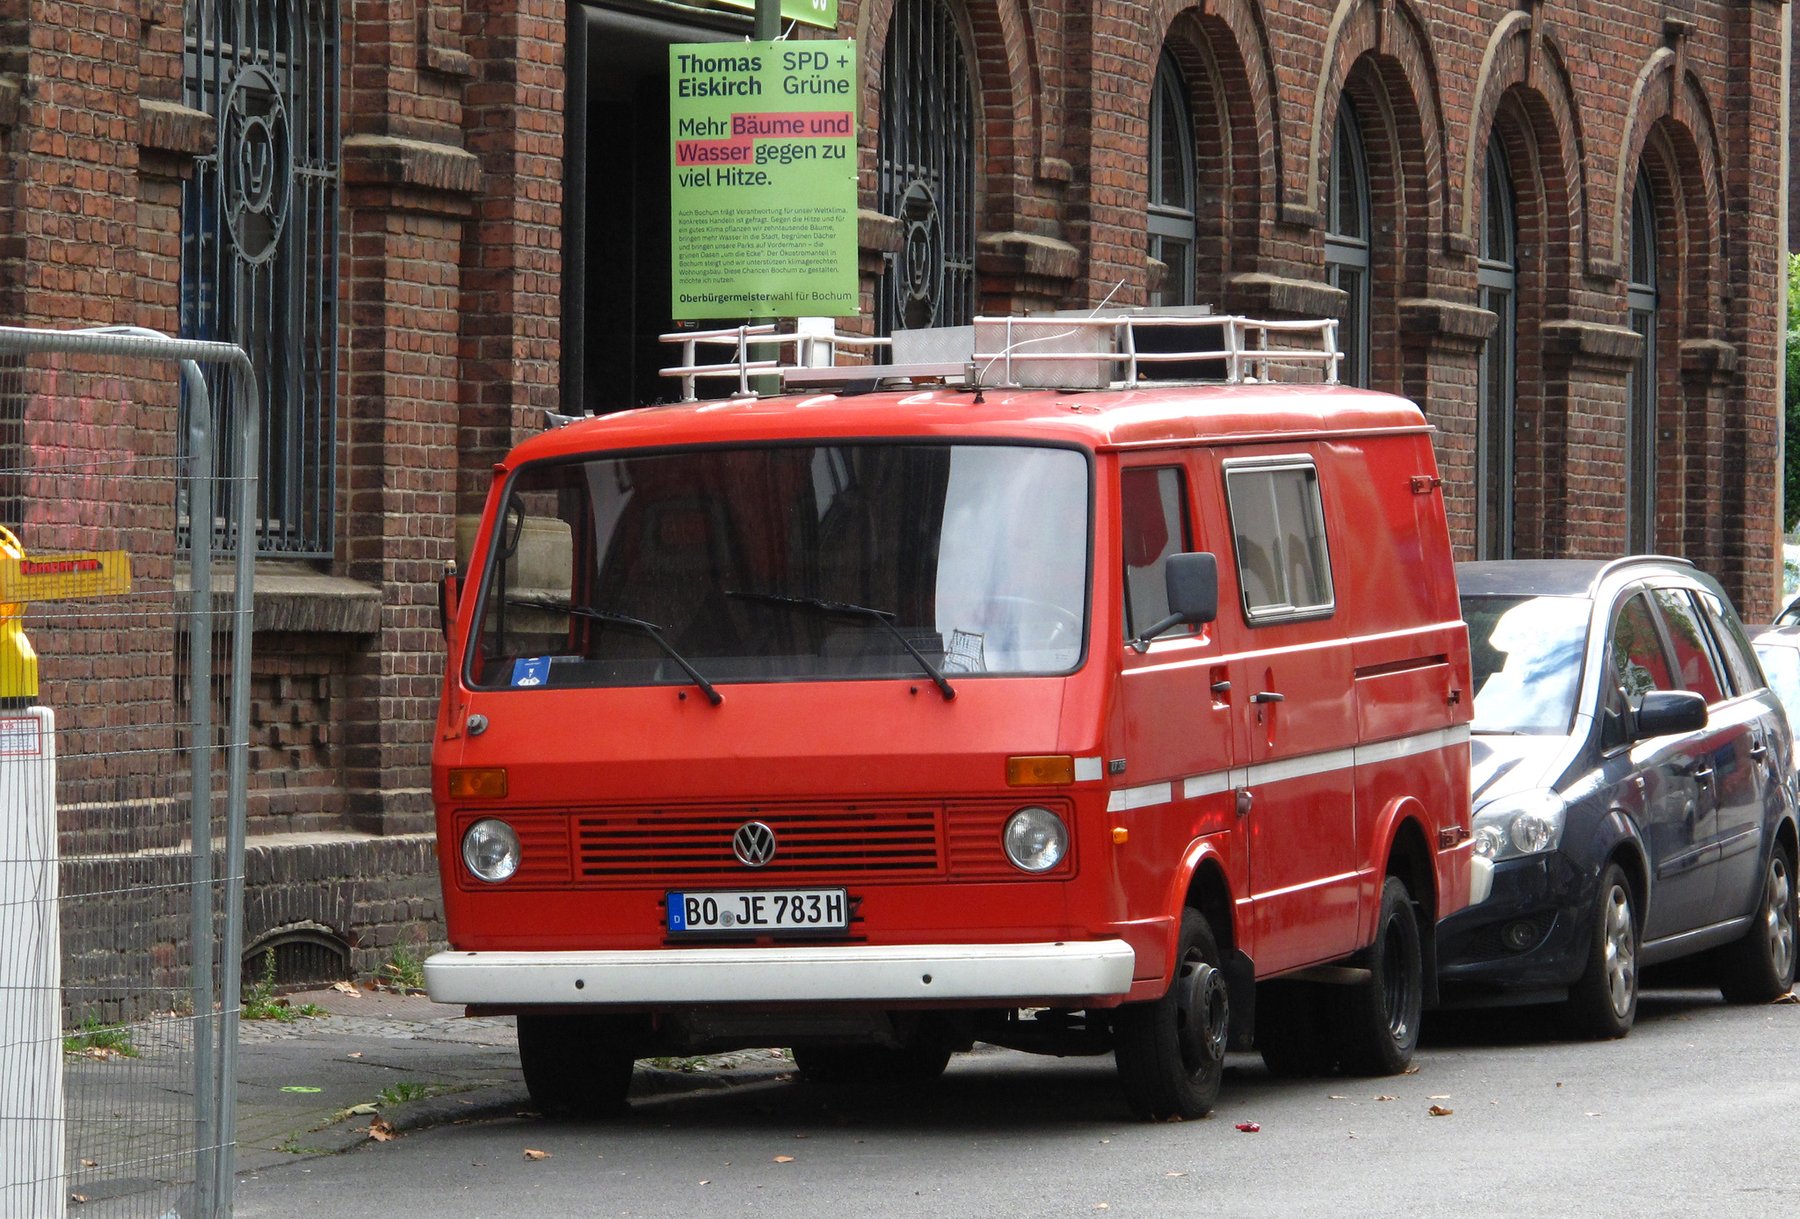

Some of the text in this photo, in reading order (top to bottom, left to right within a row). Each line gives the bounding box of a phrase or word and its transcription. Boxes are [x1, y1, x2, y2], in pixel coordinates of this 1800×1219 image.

[678, 54, 762, 73] Thomas
[783, 52, 848, 71] SPD +
[679, 76, 762, 97] Eiskirch
[783, 75, 850, 94] Grüne
[679, 114, 849, 136] Mehr Bäume und
[678, 143, 845, 164] Wasser gegen zu
[678, 167, 772, 187] viel Hitze.
[679, 291, 852, 303] Oberbürgermeisterwahl für Bochum
[674, 915, 681, 923] D
[686, 897, 718, 925] BO
[736, 896, 768, 925] JE
